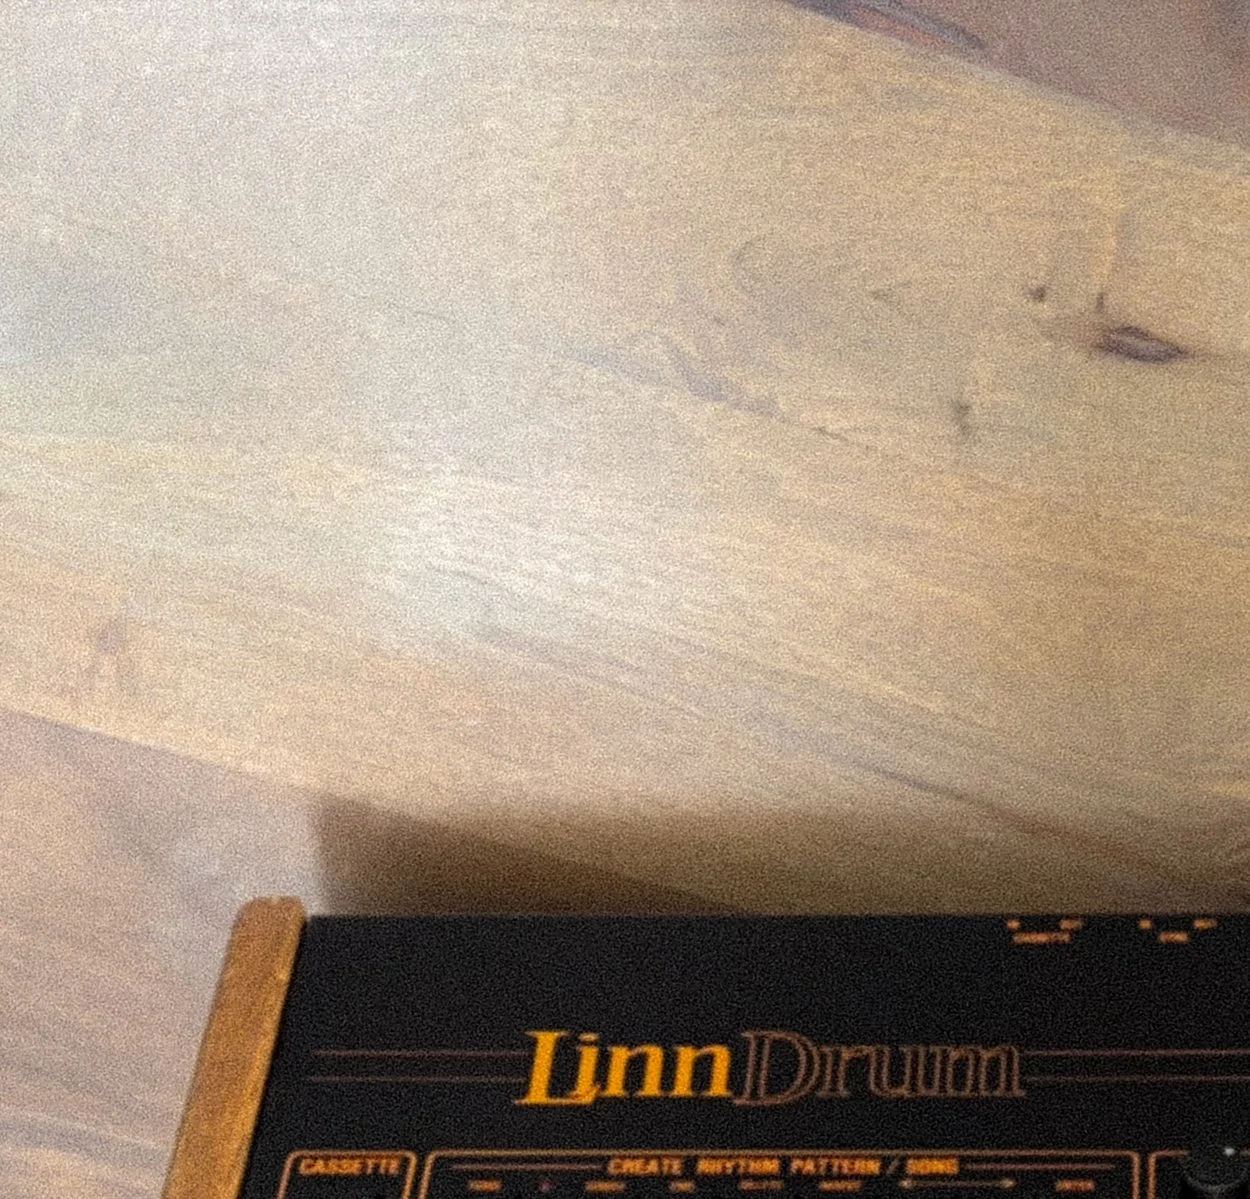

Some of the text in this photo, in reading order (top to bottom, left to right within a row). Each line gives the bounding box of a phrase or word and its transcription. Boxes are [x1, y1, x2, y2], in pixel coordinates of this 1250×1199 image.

[298, 1158, 400, 1176] CASSETTE
[607, 1158, 684, 1176] CREATE
[696, 1158, 780, 1176] RHYTHM
[790, 1158, 882, 1176] PATTERN
[906, 1158, 960, 1176] SONG
